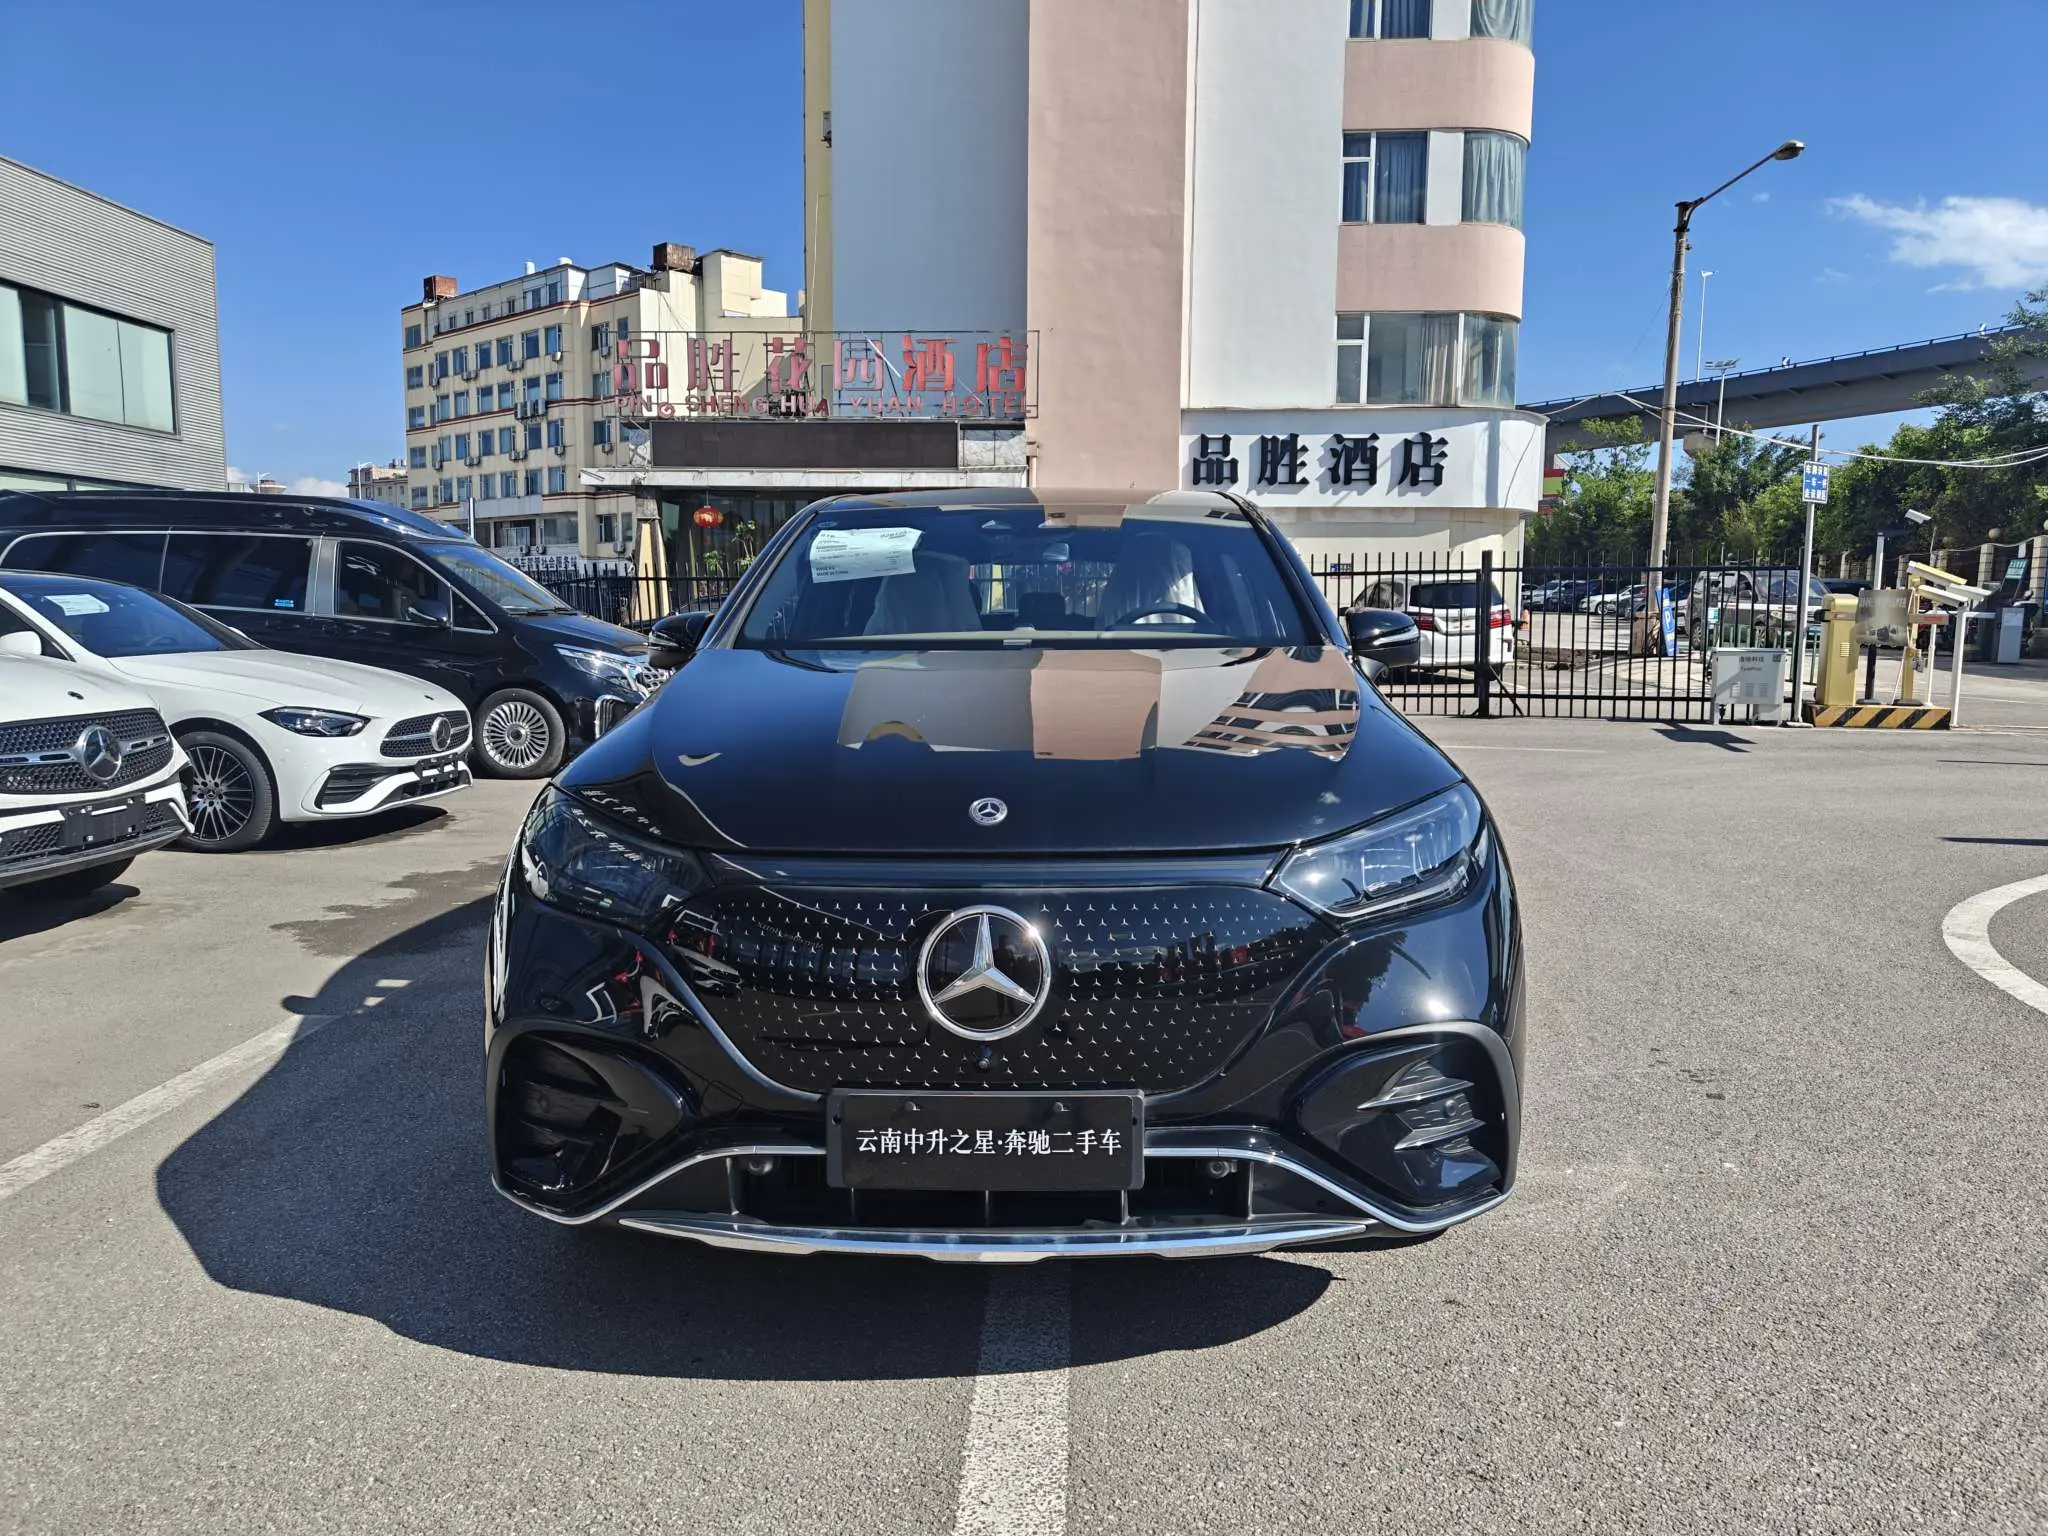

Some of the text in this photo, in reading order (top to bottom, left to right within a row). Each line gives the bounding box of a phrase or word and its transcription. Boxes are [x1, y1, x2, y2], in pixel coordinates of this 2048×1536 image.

[613, 334, 1028, 394] 品胜花园酒店
[614, 394, 1032, 418] PING SHENG HUA YUAN HOTEL
[1192, 432, 1449, 487] 品胜酒店
[855, 1128, 1122, 1156] 云南中升之星·奔驰二手车
